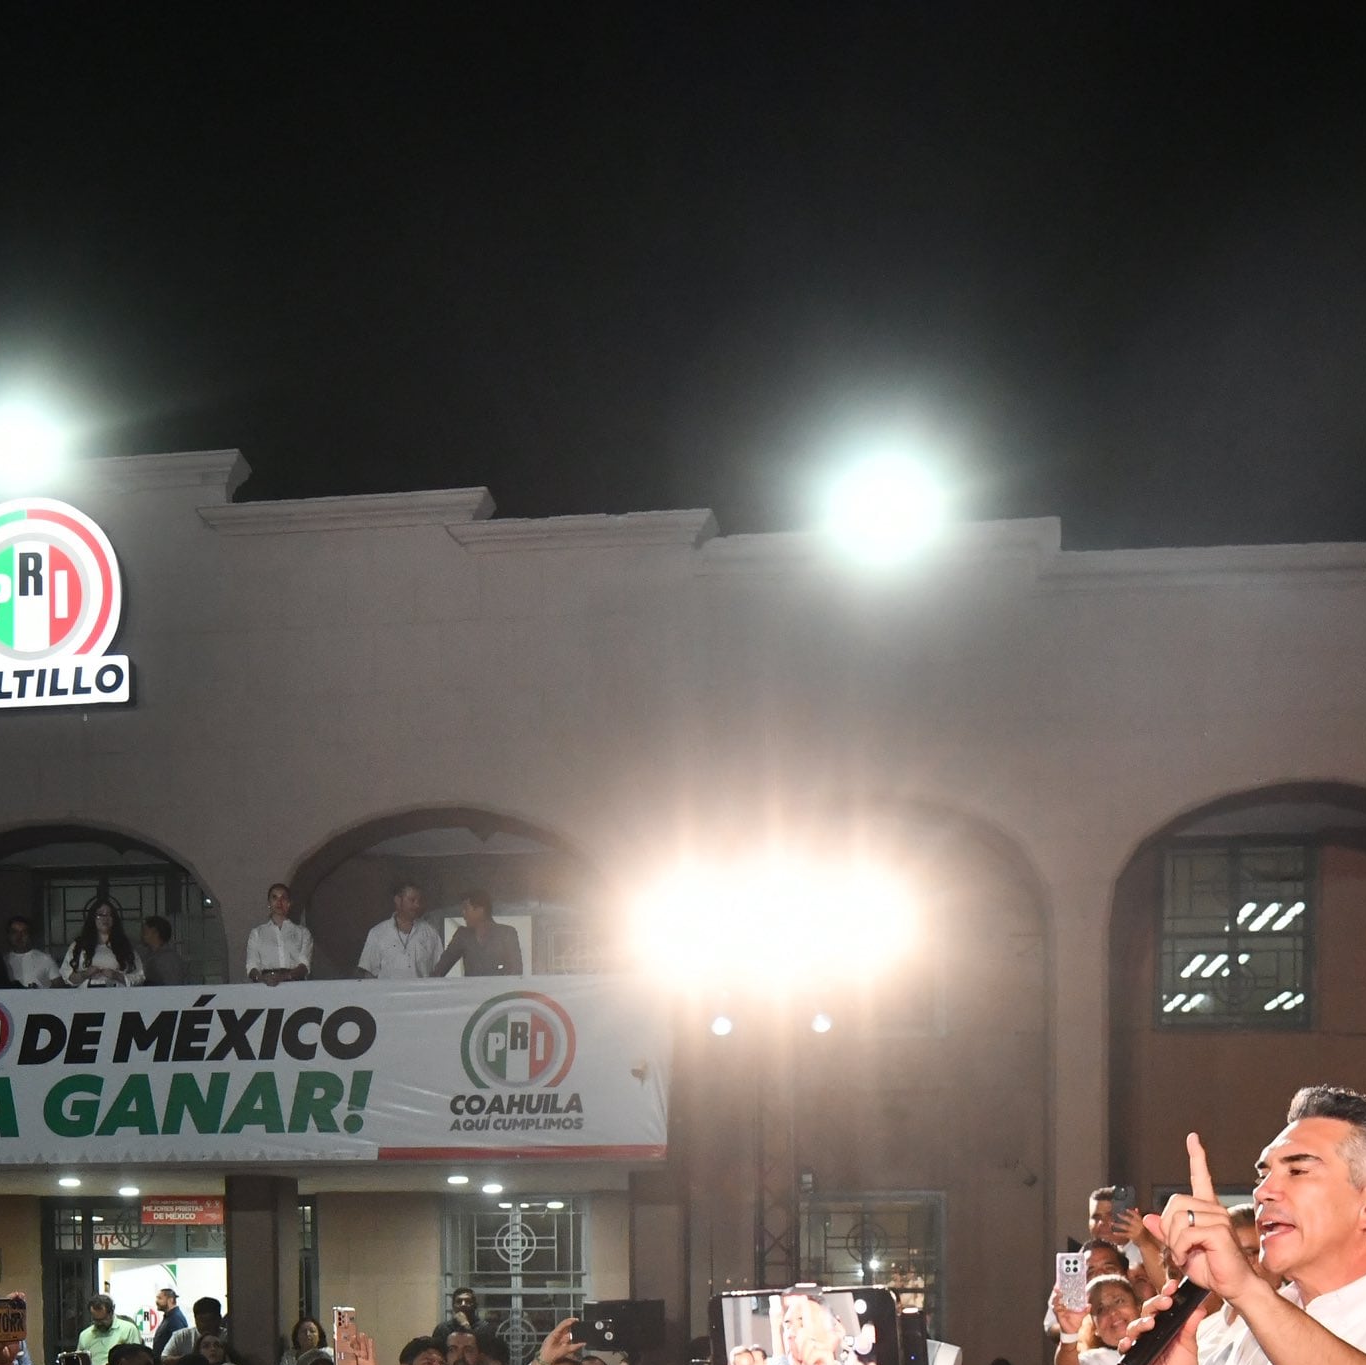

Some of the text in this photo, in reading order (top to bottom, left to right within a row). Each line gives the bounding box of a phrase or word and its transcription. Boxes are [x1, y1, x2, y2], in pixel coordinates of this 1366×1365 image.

[17, 1012, 106, 1066] DE
[112, 993, 377, 1064] MÉXICO
[486, 1021, 545, 1062] PRI
[43, 1070, 374, 1138] GANAR!
[449, 1093, 584, 1116] COAHUILA
[449, 1115, 584, 1132] AQUÍ CUMPLIMOS
